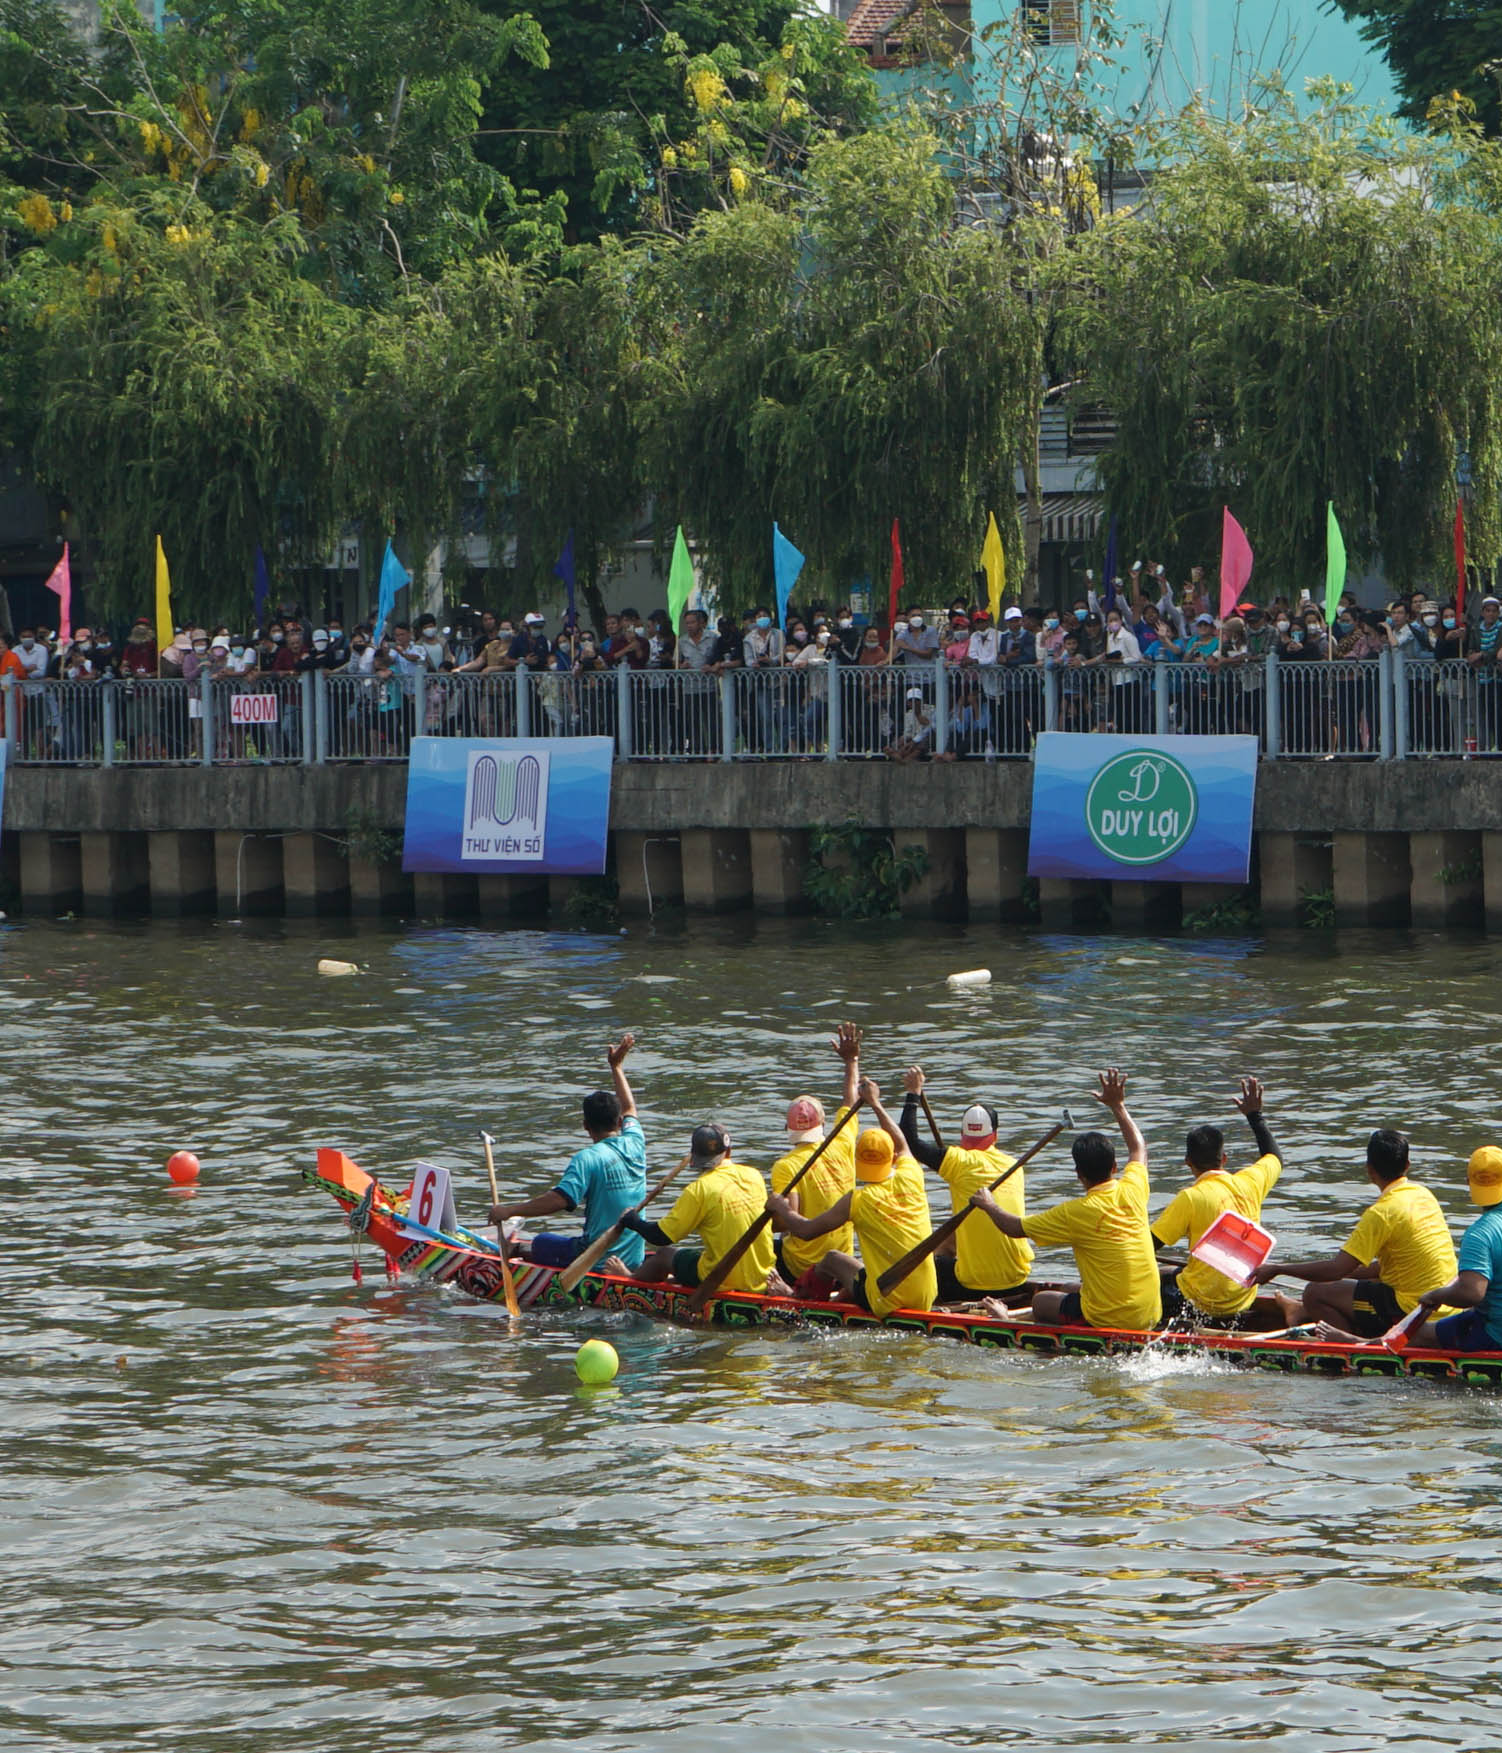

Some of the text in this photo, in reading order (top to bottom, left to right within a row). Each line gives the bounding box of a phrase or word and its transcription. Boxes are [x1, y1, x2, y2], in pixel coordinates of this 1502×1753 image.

[232, 696, 275, 721] 400M
[1101, 808, 1179, 845] DUY LỢI
[466, 835, 542, 856] THƯ VIỆN SỐ
[418, 1170, 437, 1226] 6
